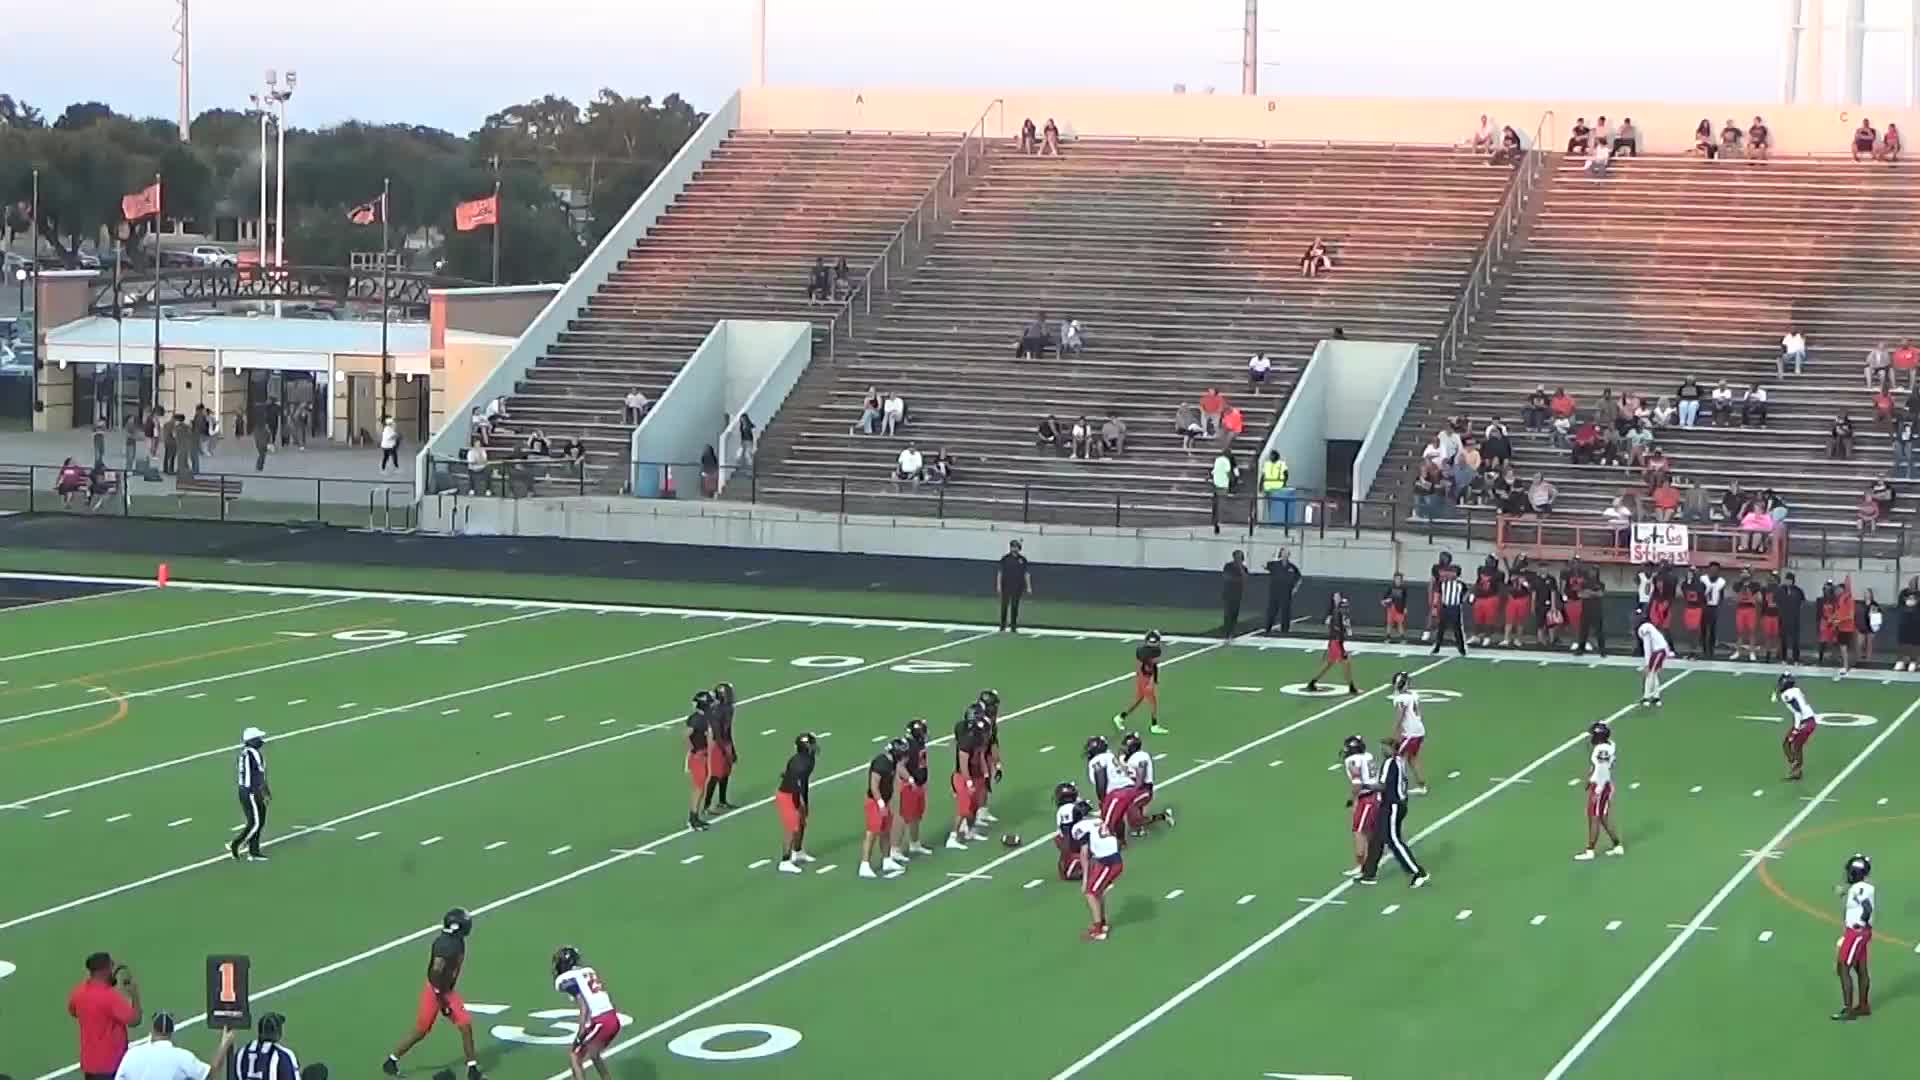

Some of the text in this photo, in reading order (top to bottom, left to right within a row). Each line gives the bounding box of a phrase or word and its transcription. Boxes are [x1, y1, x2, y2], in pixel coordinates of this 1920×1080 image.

[855, 94, 864, 105] A
[1839, 111, 1849, 122] C
[218, 962, 237, 1002] 1
[246, 1052, 264, 1080] L
